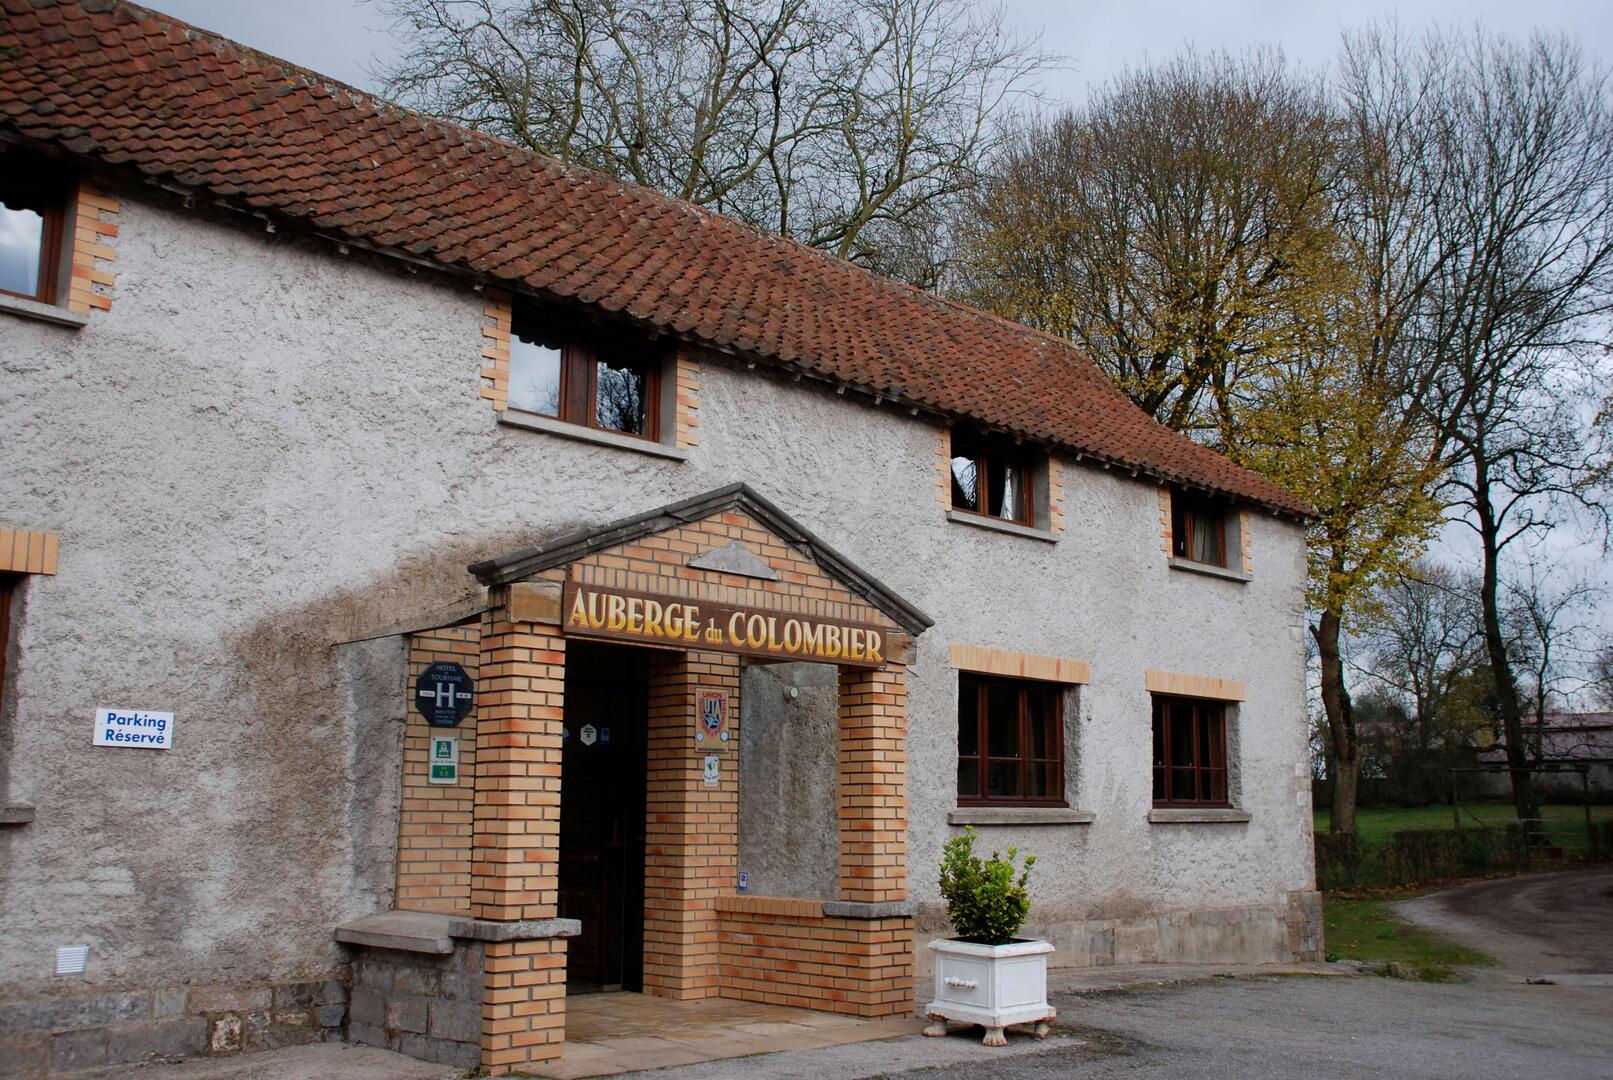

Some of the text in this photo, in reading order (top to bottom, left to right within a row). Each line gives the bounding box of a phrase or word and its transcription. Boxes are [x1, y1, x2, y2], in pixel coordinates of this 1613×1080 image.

[567, 587, 883, 663] AUBERGE du COLOMBIER
[436, 664, 457, 672] HOTEL
[435, 682, 455, 708] H
[107, 712, 167, 731] Parking
[105, 728, 165, 744] Réservé
